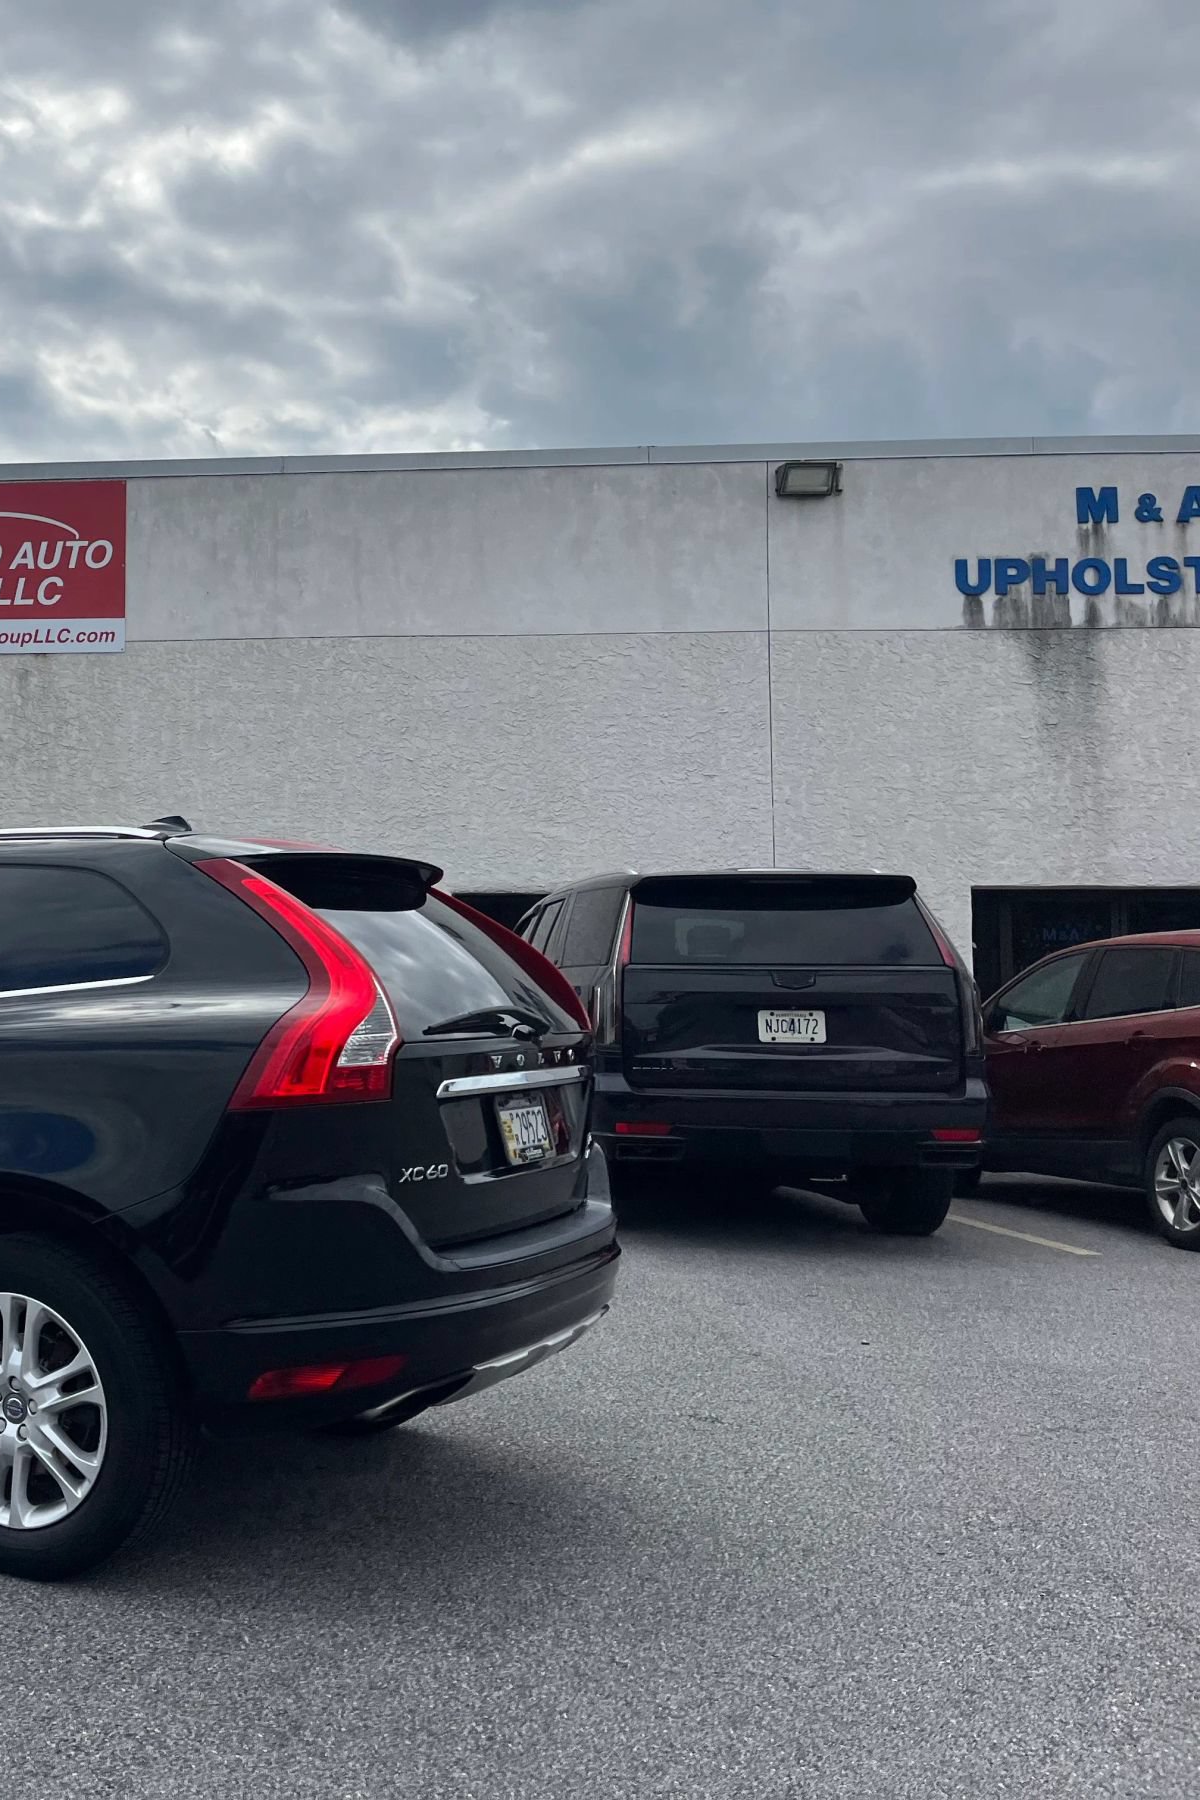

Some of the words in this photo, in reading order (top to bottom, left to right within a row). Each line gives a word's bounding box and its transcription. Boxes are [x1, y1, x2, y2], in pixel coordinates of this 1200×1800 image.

[1075, 486, 1119, 523] M
[1134, 493, 1164, 523] &
[1176, 485, 1200, 523] A
[9, 539, 113, 570] AUTO
[490, 1048, 575, 1069] VOLVO
[399, 1163, 449, 1183] XC60
